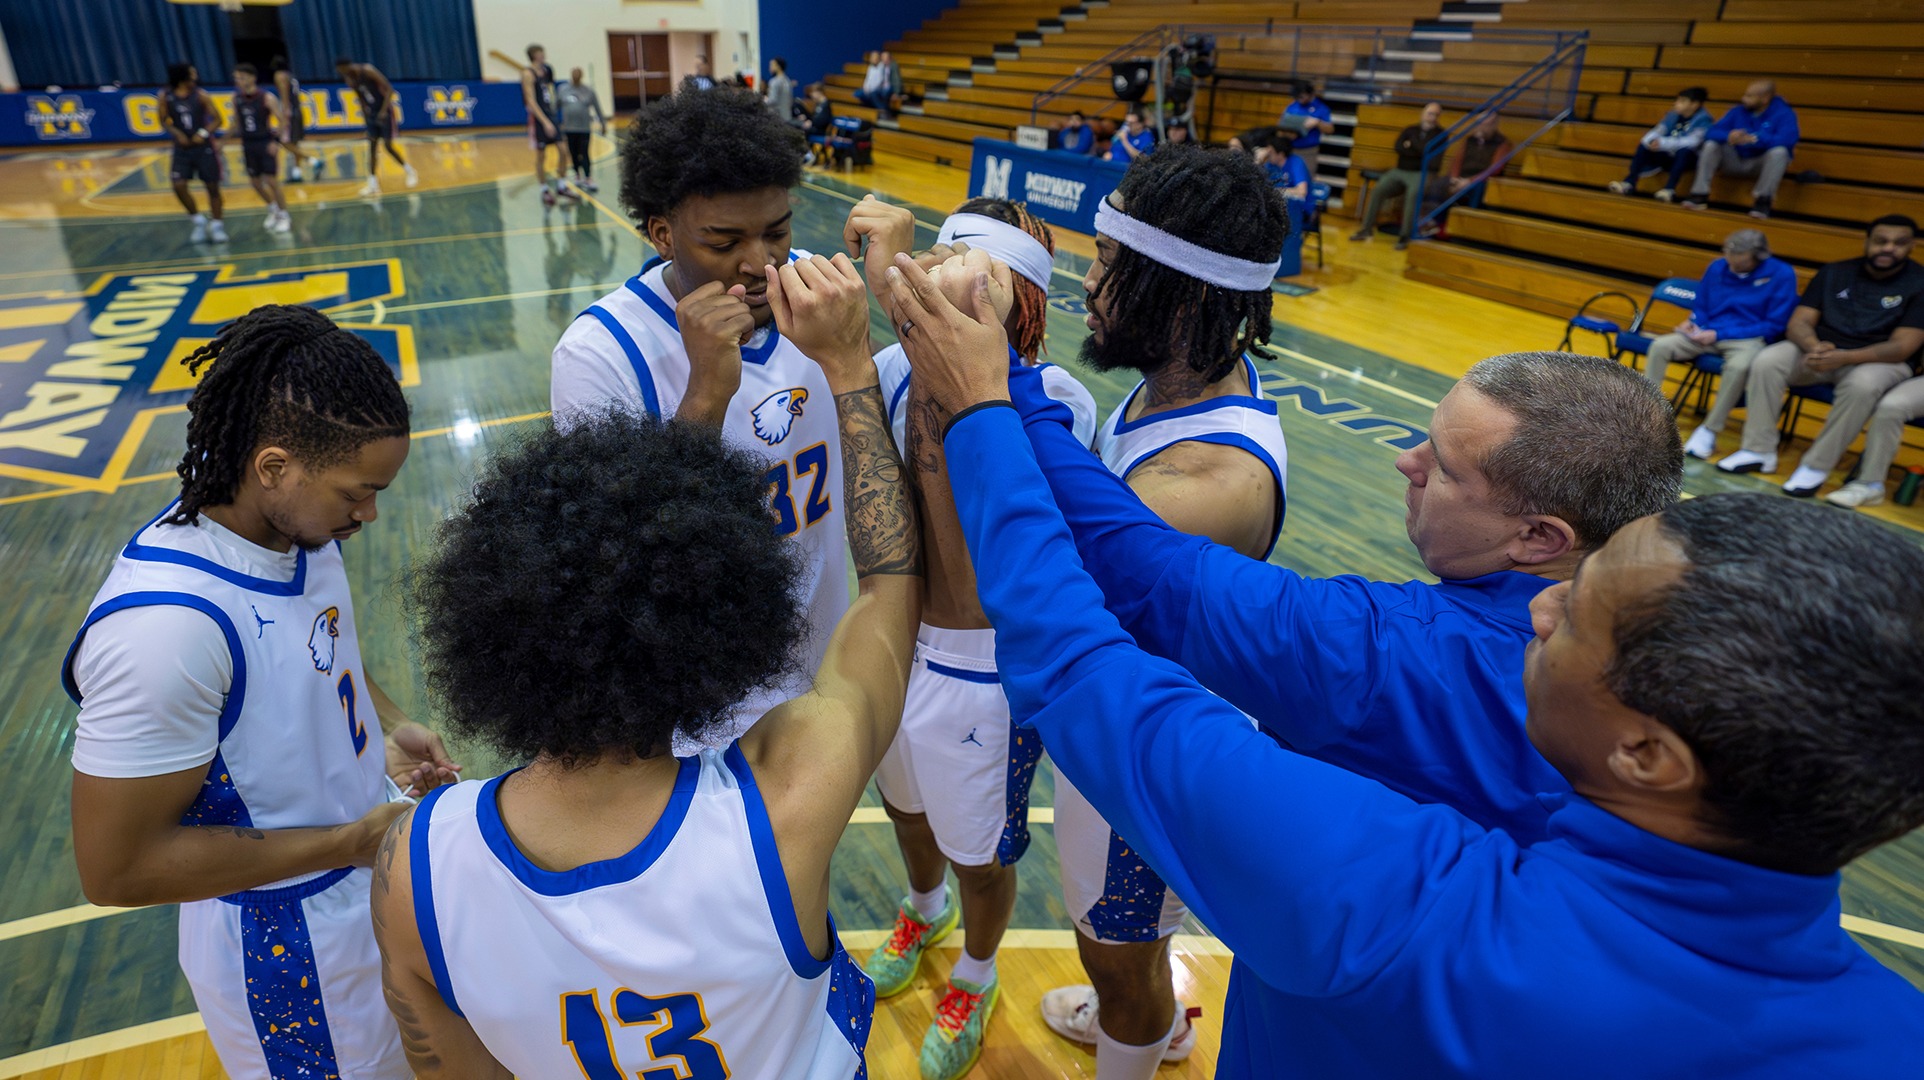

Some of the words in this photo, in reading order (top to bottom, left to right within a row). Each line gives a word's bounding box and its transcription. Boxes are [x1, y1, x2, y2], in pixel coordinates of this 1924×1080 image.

[982, 154, 1013, 201] M
[1024, 171, 1086, 201] MIDWAY
[1026, 191, 1079, 214] UNIVERSITY
[0, 272, 199, 459] MIDWAY
[763, 440, 833, 540] 32
[337, 669, 369, 759] 2
[559, 986, 732, 1080] 13
